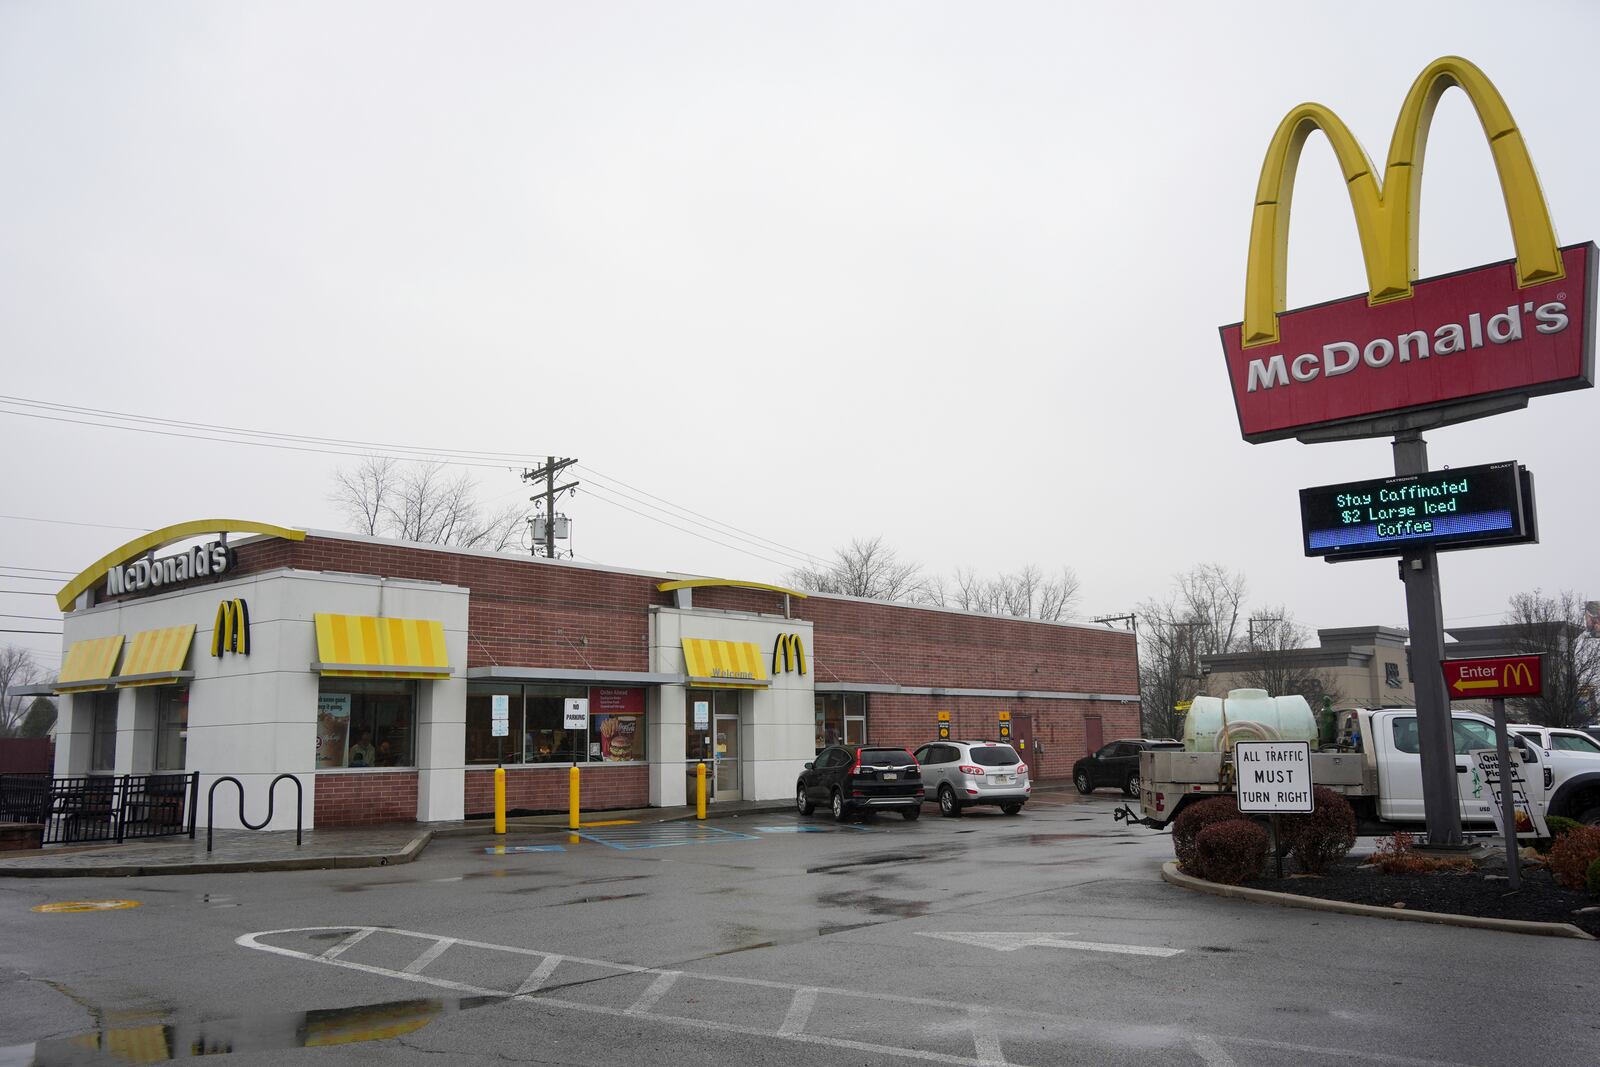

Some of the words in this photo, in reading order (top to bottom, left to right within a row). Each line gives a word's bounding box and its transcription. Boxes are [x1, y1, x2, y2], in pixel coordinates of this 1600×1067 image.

[1247, 301, 1569, 393] McDonald's
[1337, 494, 1371, 508] Stay
[1380, 479, 1468, 502] Caffinated
[1341, 509, 1361, 524] $2
[1369, 504, 1416, 521] Large
[1424, 499, 1456, 514] Iced
[1377, 521, 1433, 537] Coffee
[106, 543, 227, 597] McDonald's
[712, 668, 753, 679] Welcome
[1460, 666, 1497, 678] Enter
[1243, 751, 1261, 762] ALL
[1265, 750, 1304, 762] TRAFFIC
[1483, 754, 1498, 762] Qui
[1254, 770, 1294, 783] MUST
[1242, 791, 1270, 803] TURN
[1277, 791, 1308, 803] RIGHT
